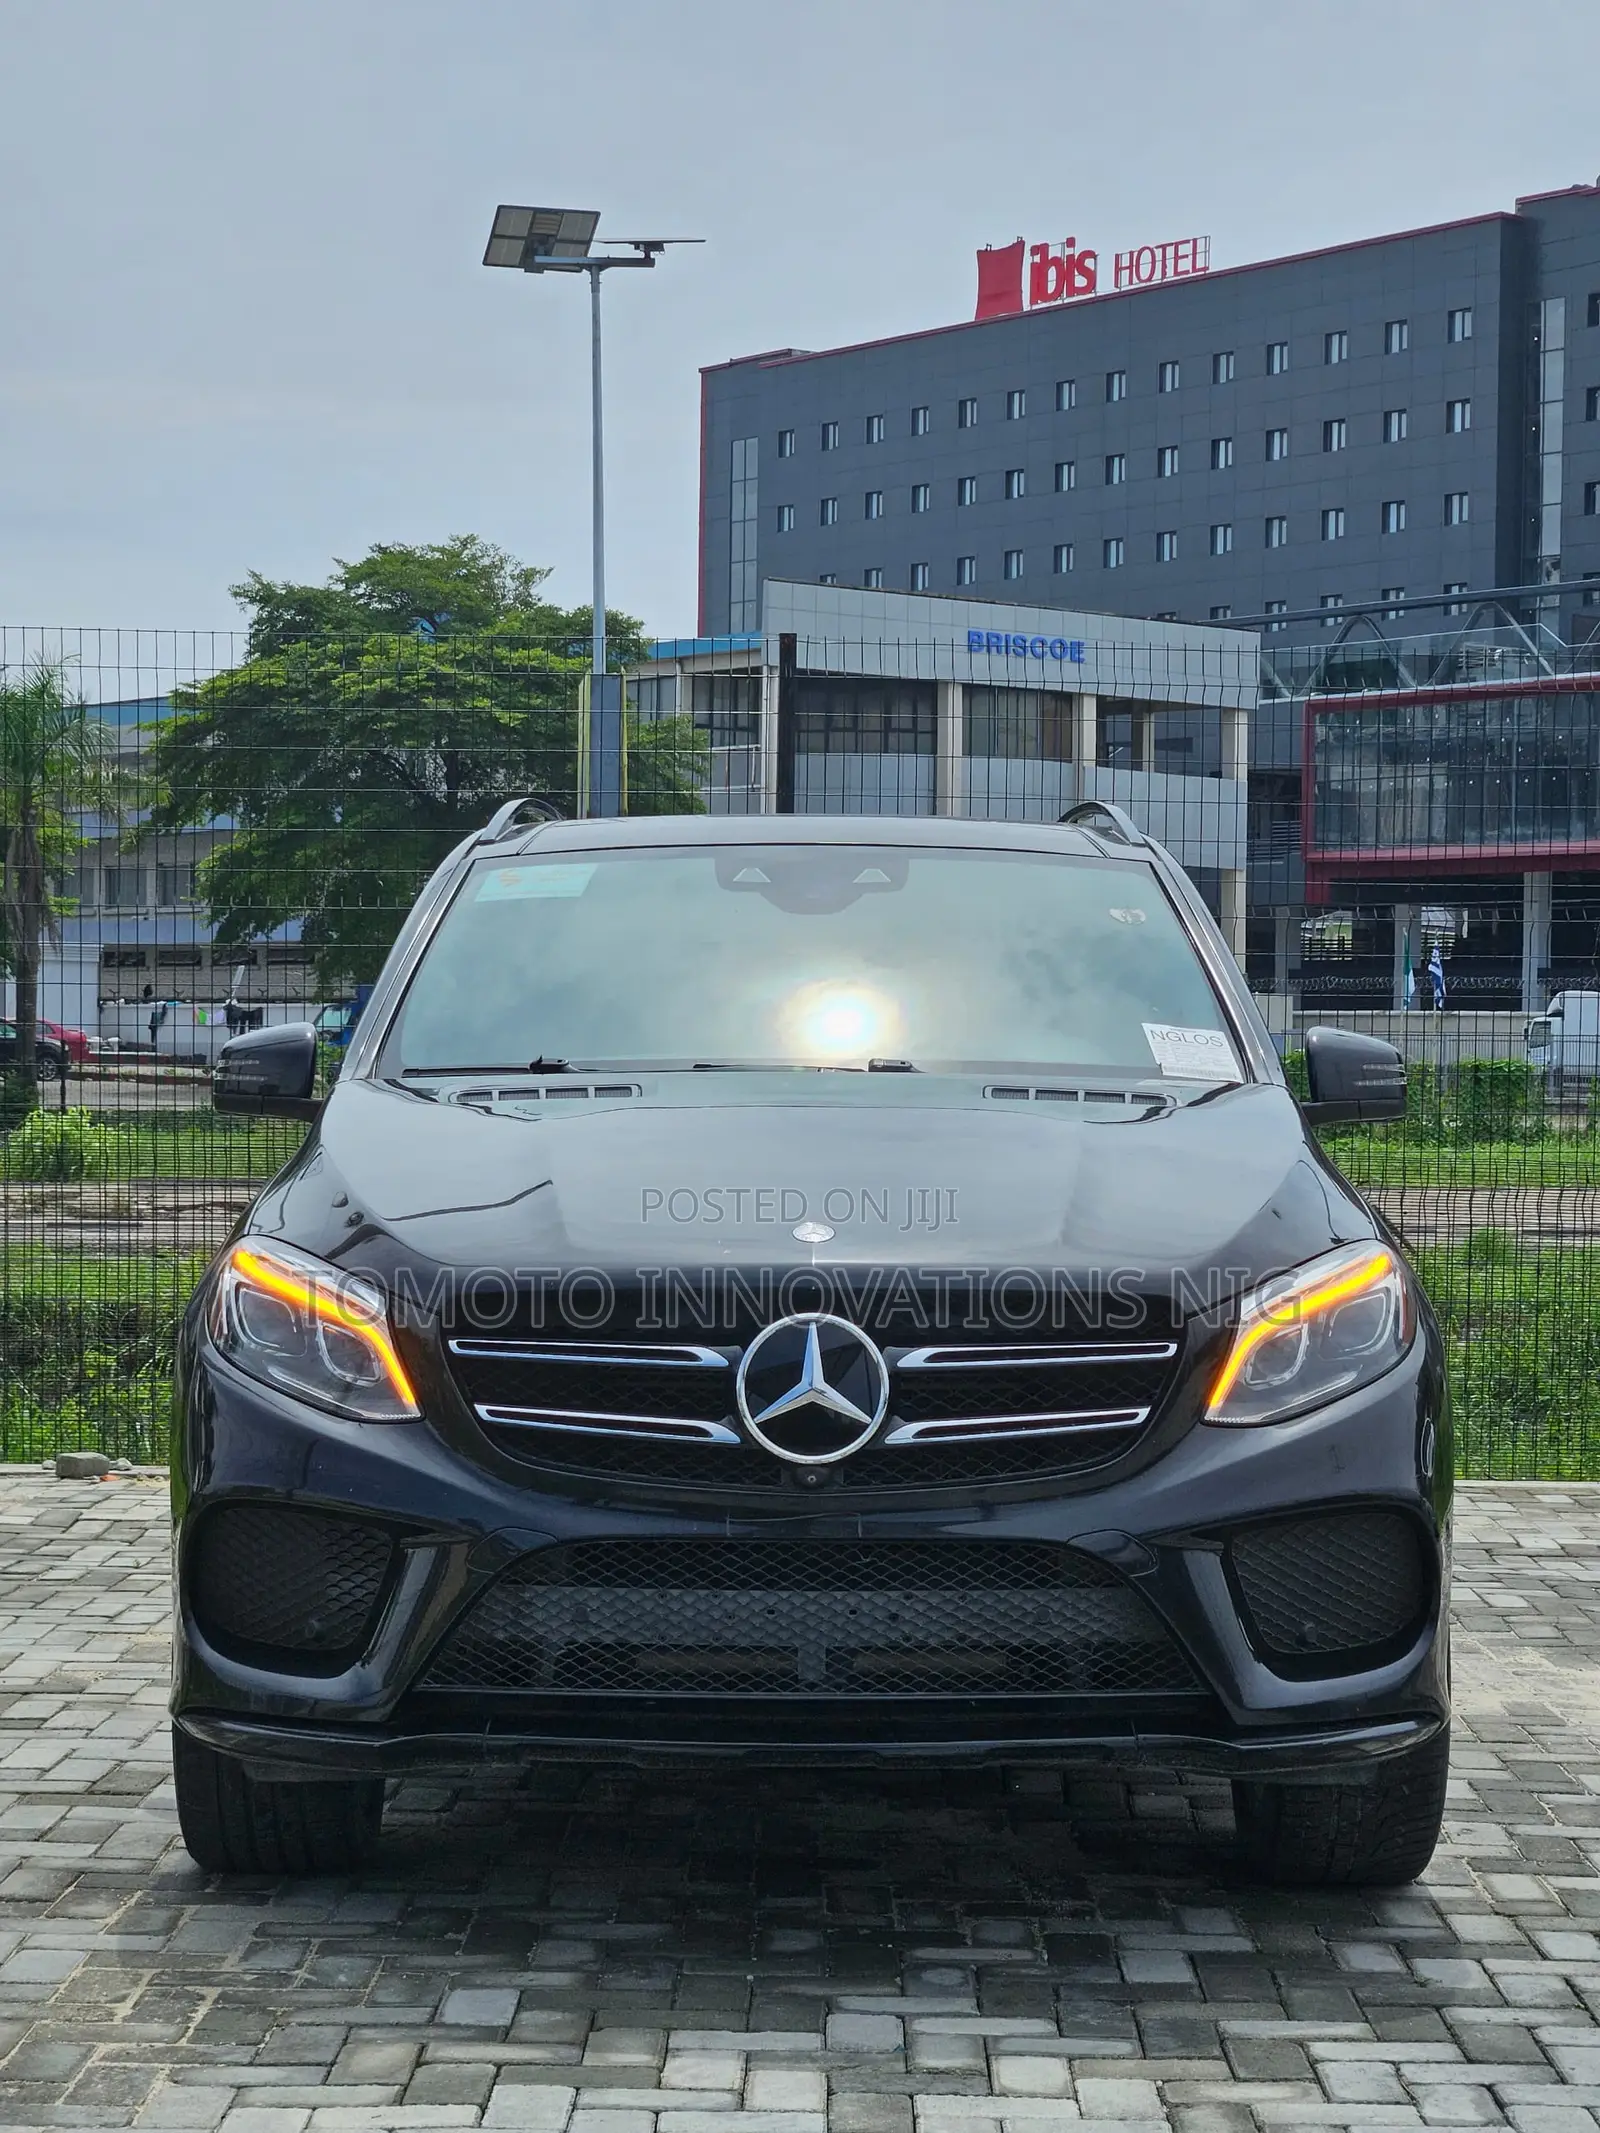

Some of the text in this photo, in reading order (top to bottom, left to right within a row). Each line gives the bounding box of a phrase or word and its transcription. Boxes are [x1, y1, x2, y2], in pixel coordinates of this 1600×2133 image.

[1030, 237, 1209, 305] ibis HOTEL
[967, 630, 1085, 664] BRISCOE
[1150, 1030, 1223, 1048] NGLOS
